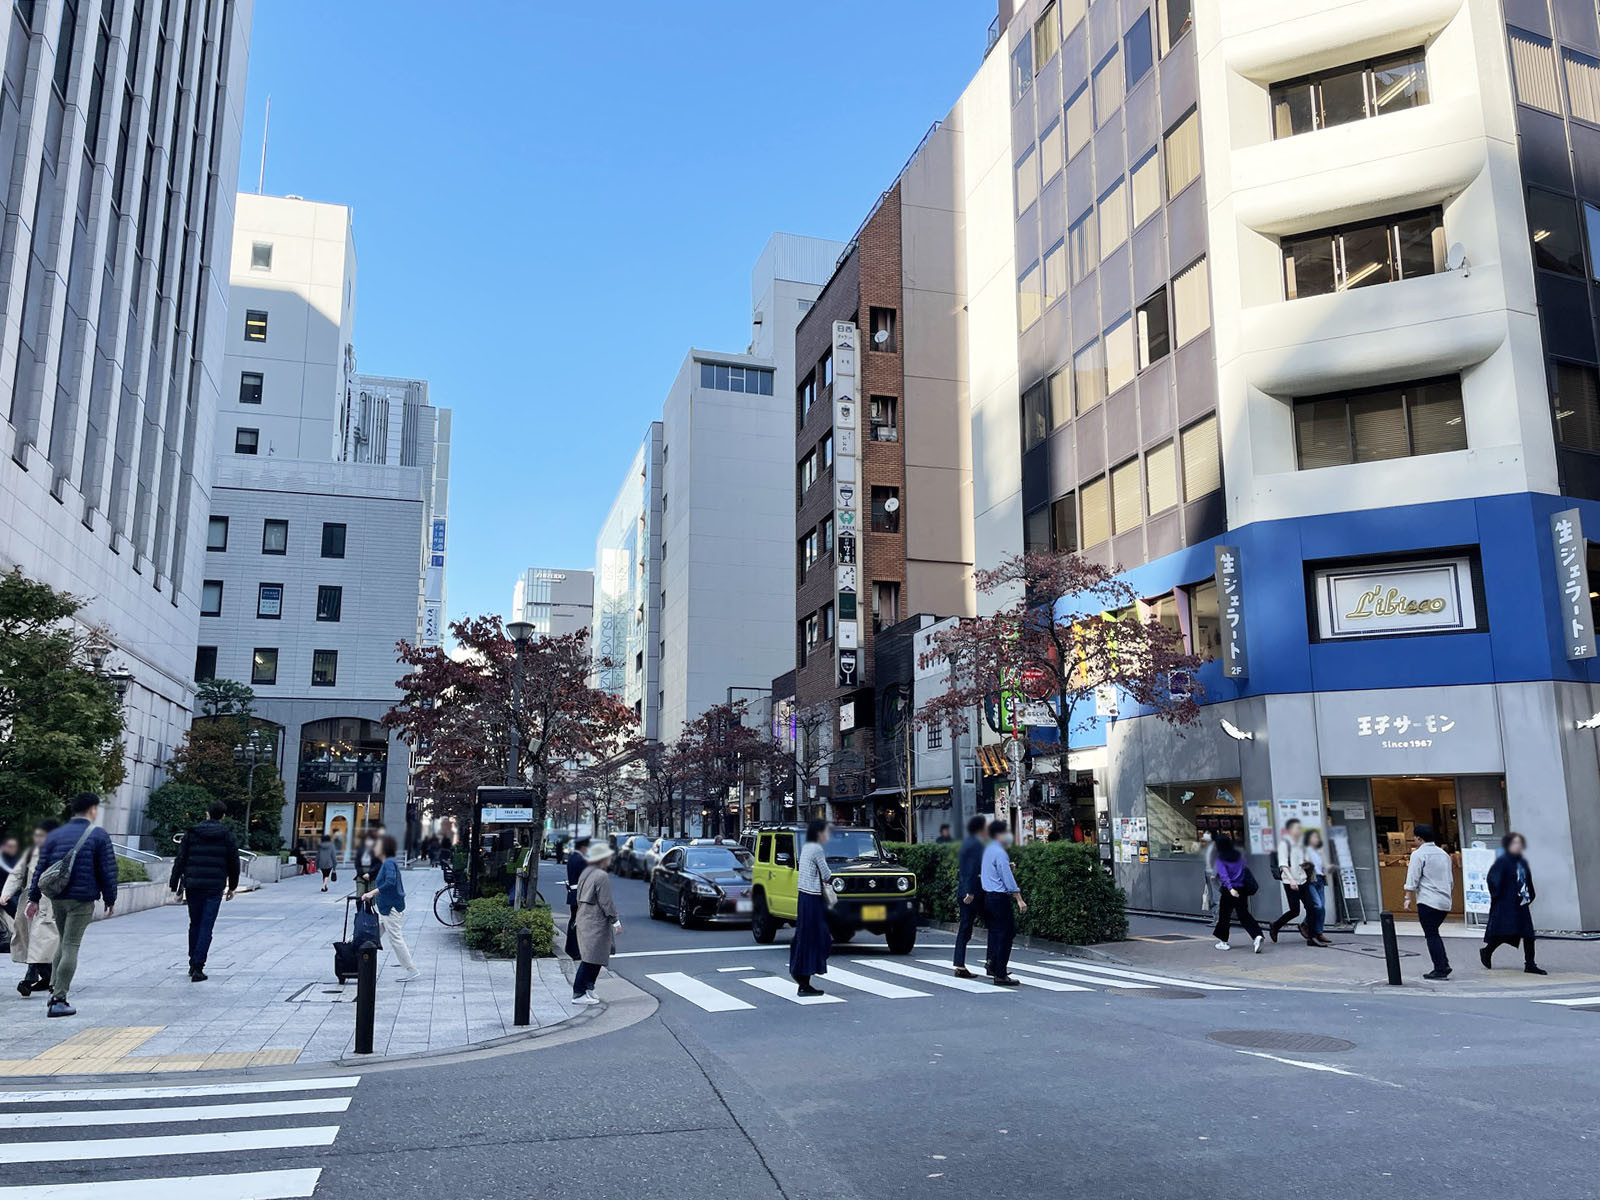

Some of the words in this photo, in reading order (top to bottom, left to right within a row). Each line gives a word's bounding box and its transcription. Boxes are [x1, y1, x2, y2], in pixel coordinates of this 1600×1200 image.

[1555, 518, 1585, 639] 生ジェラート
[1220, 552, 1242, 660] 生ジェラート
[1573, 645, 1587, 656] 2F
[1231, 666, 1242, 676] 2F
[1356, 713, 1456, 738] 王子サーモン
[1381, 740, 1408, 749] Since
[1410, 739, 1432, 748] 1967
